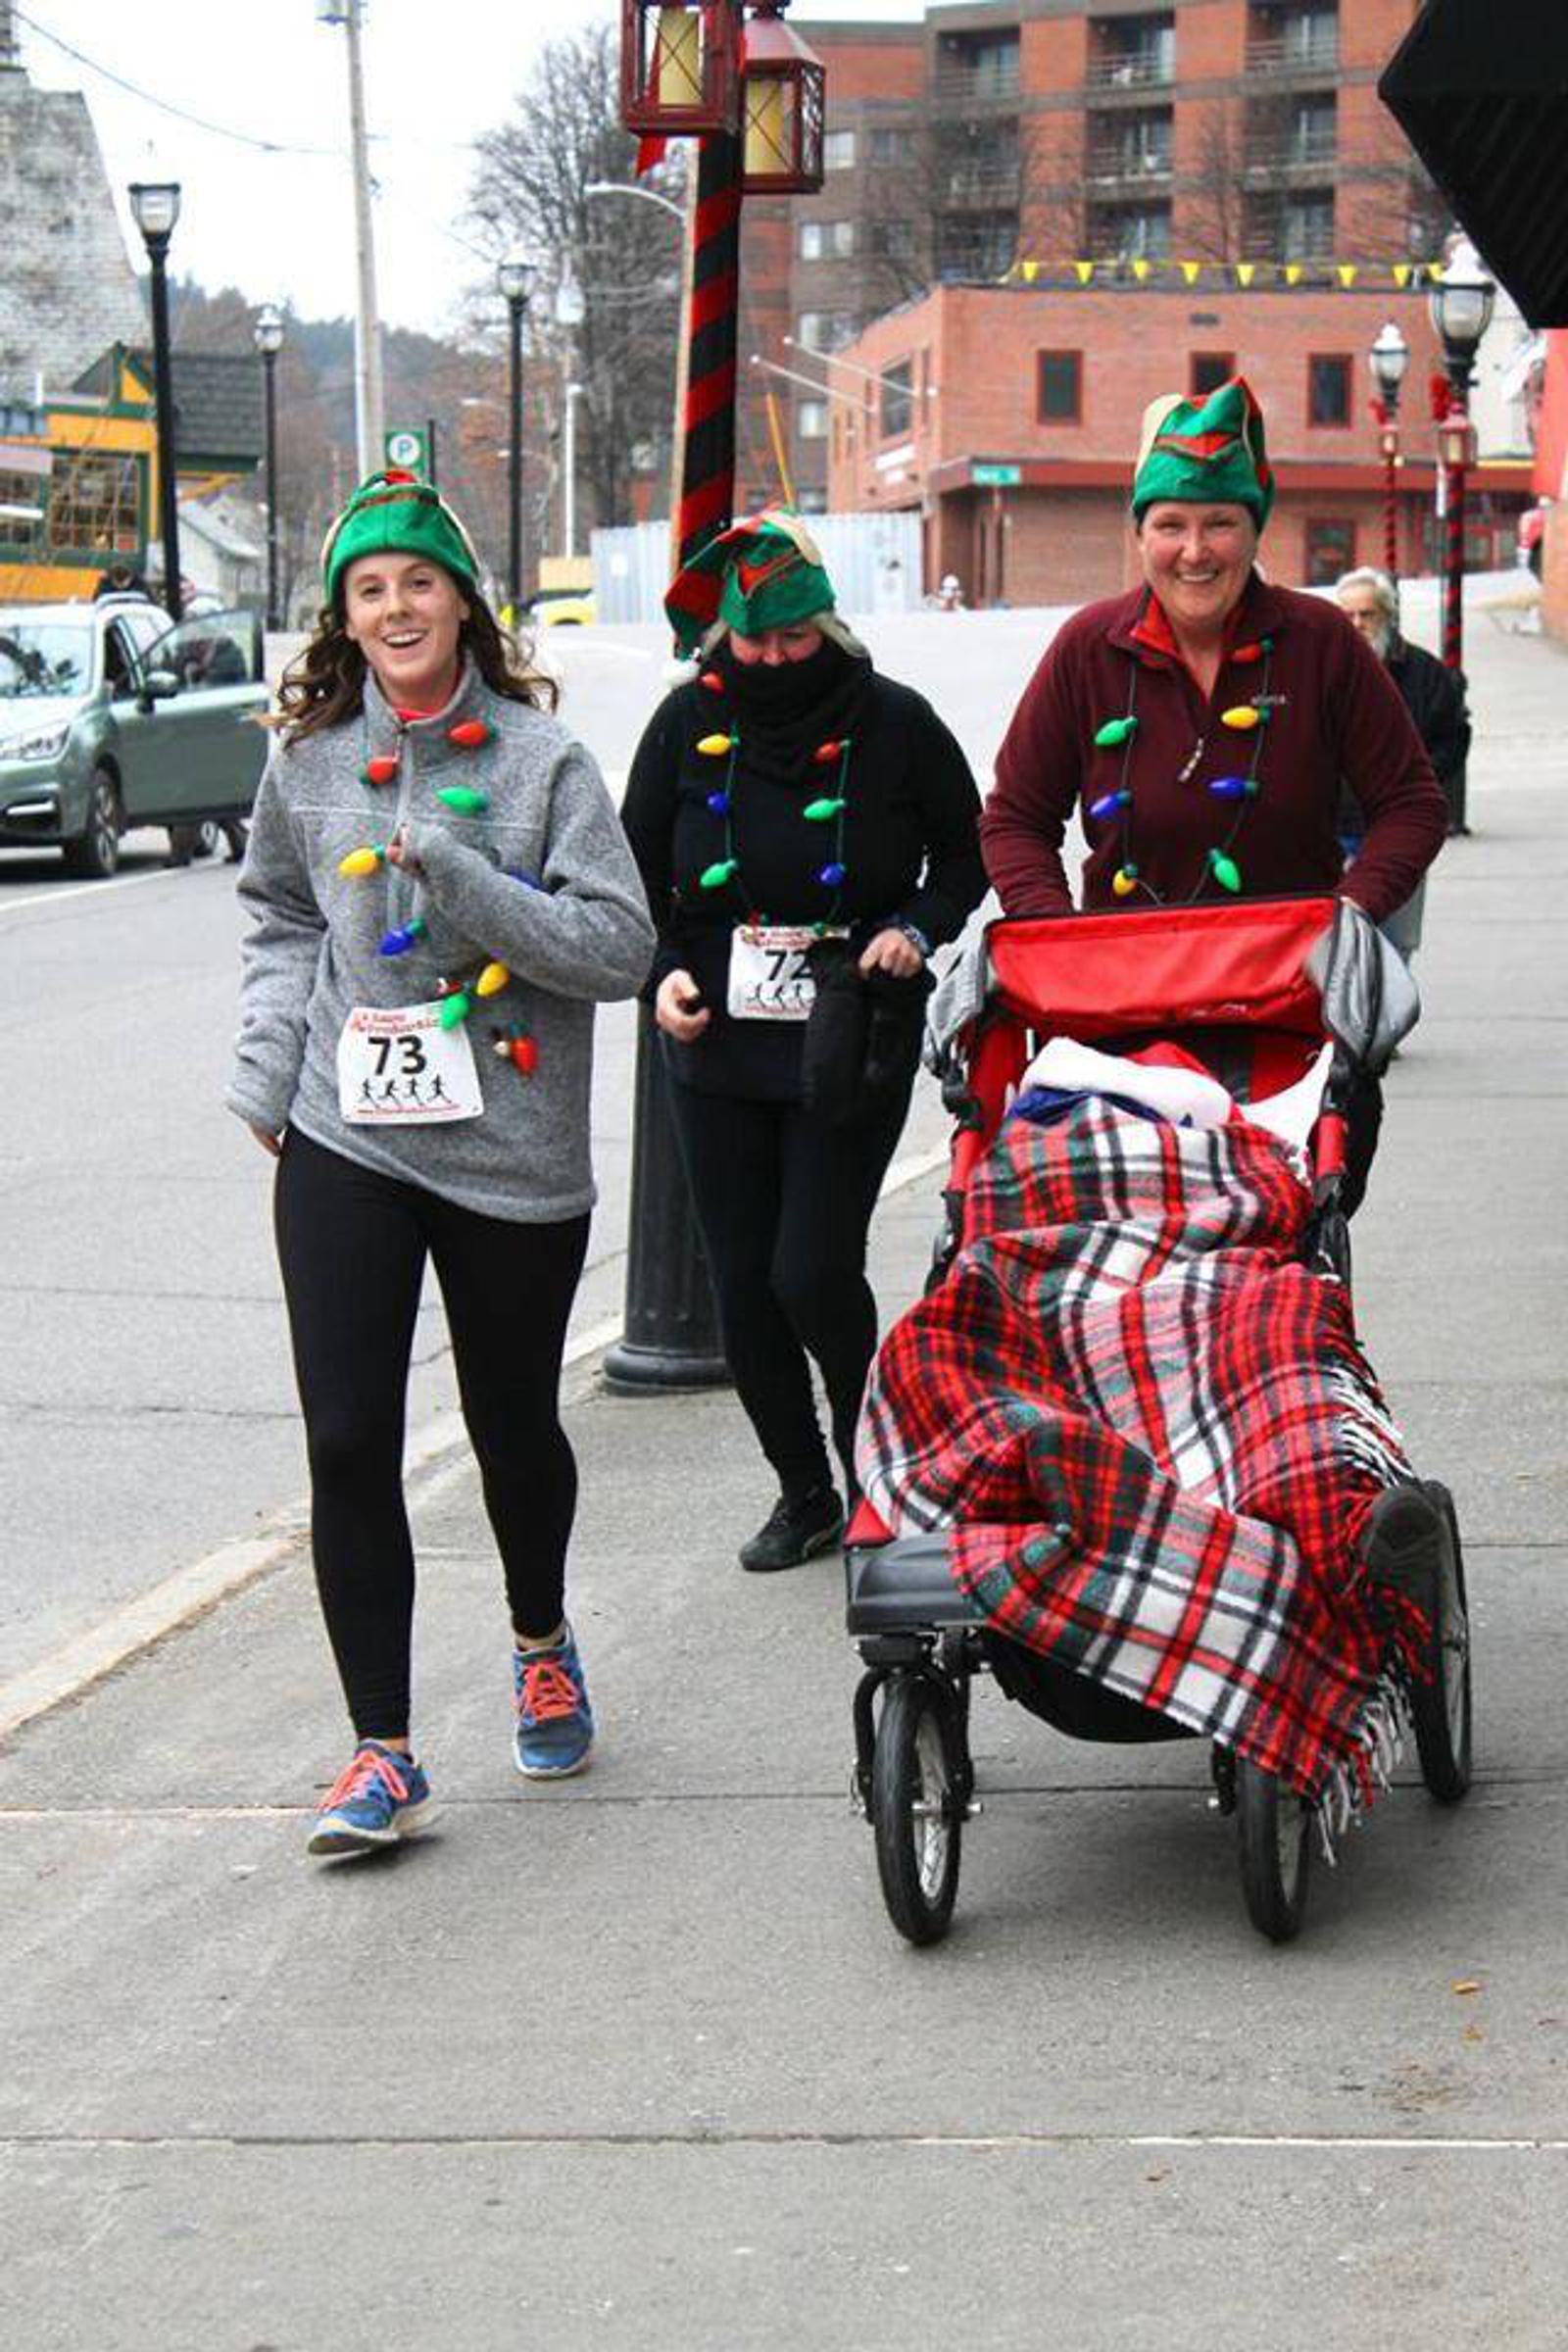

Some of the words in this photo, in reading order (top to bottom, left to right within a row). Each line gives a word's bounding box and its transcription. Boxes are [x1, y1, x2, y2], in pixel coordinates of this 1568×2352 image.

[397, 439, 413, 459] P
[764, 950, 813, 981] 72
[368, 1034, 427, 1075] 73
